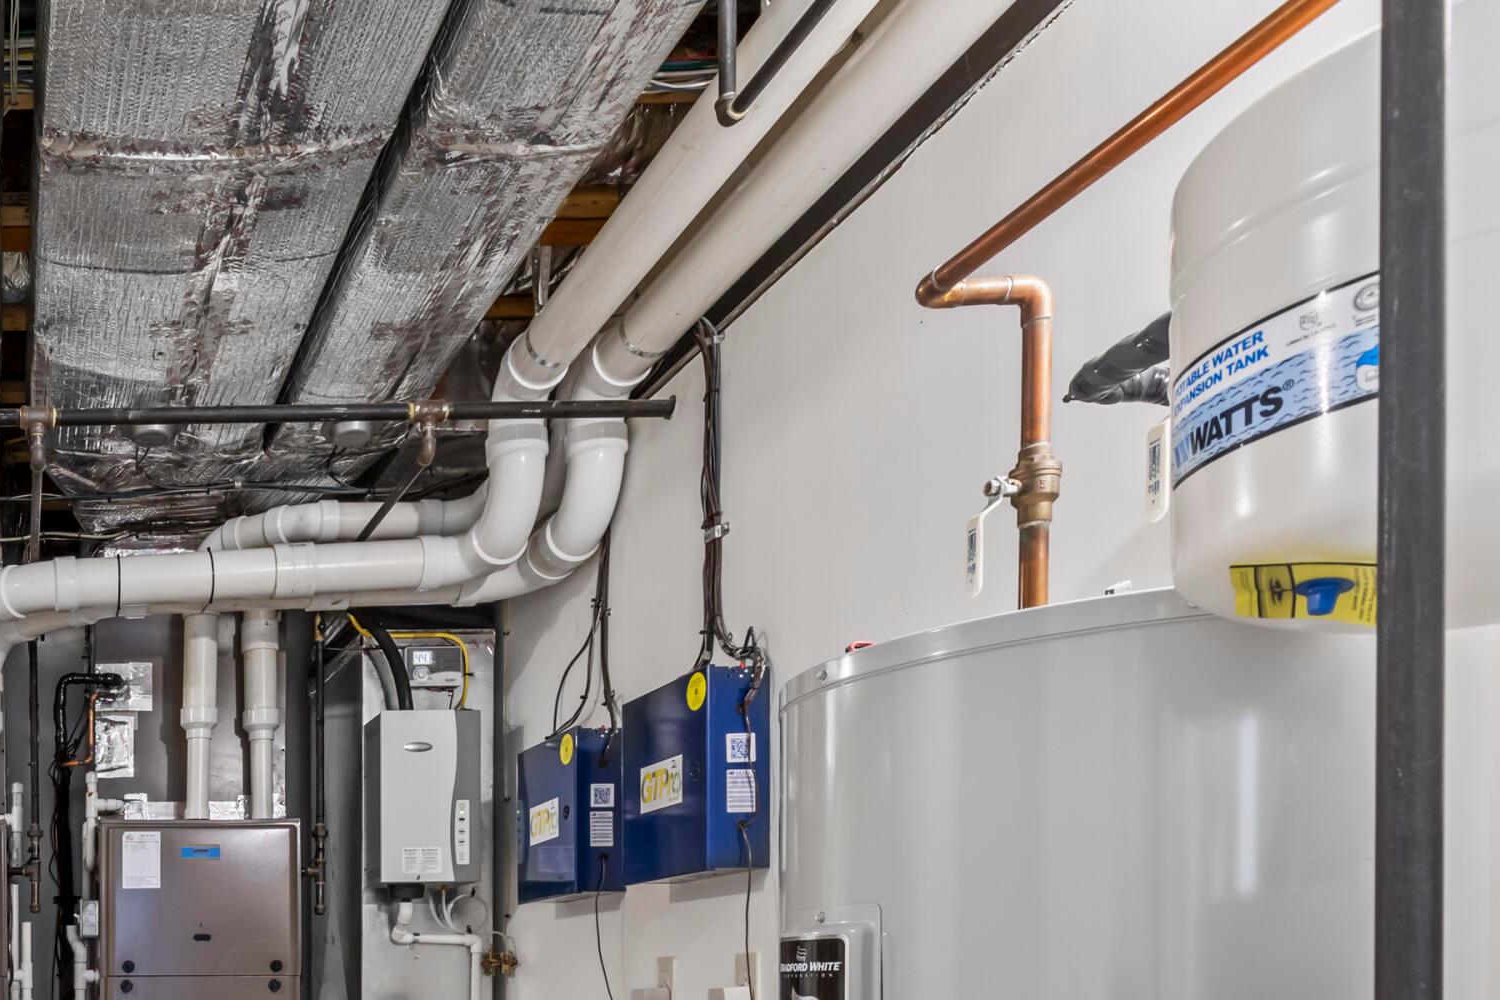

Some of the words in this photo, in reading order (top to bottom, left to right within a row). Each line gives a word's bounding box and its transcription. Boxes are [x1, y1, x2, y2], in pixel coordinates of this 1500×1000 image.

[1212, 331, 1263, 367] WATER
[1225, 344, 1269, 376] TANK
[1190, 386, 1284, 455] WATTS
[415, 653, 427, 662] 44
[809, 961, 840, 972] WHITE
